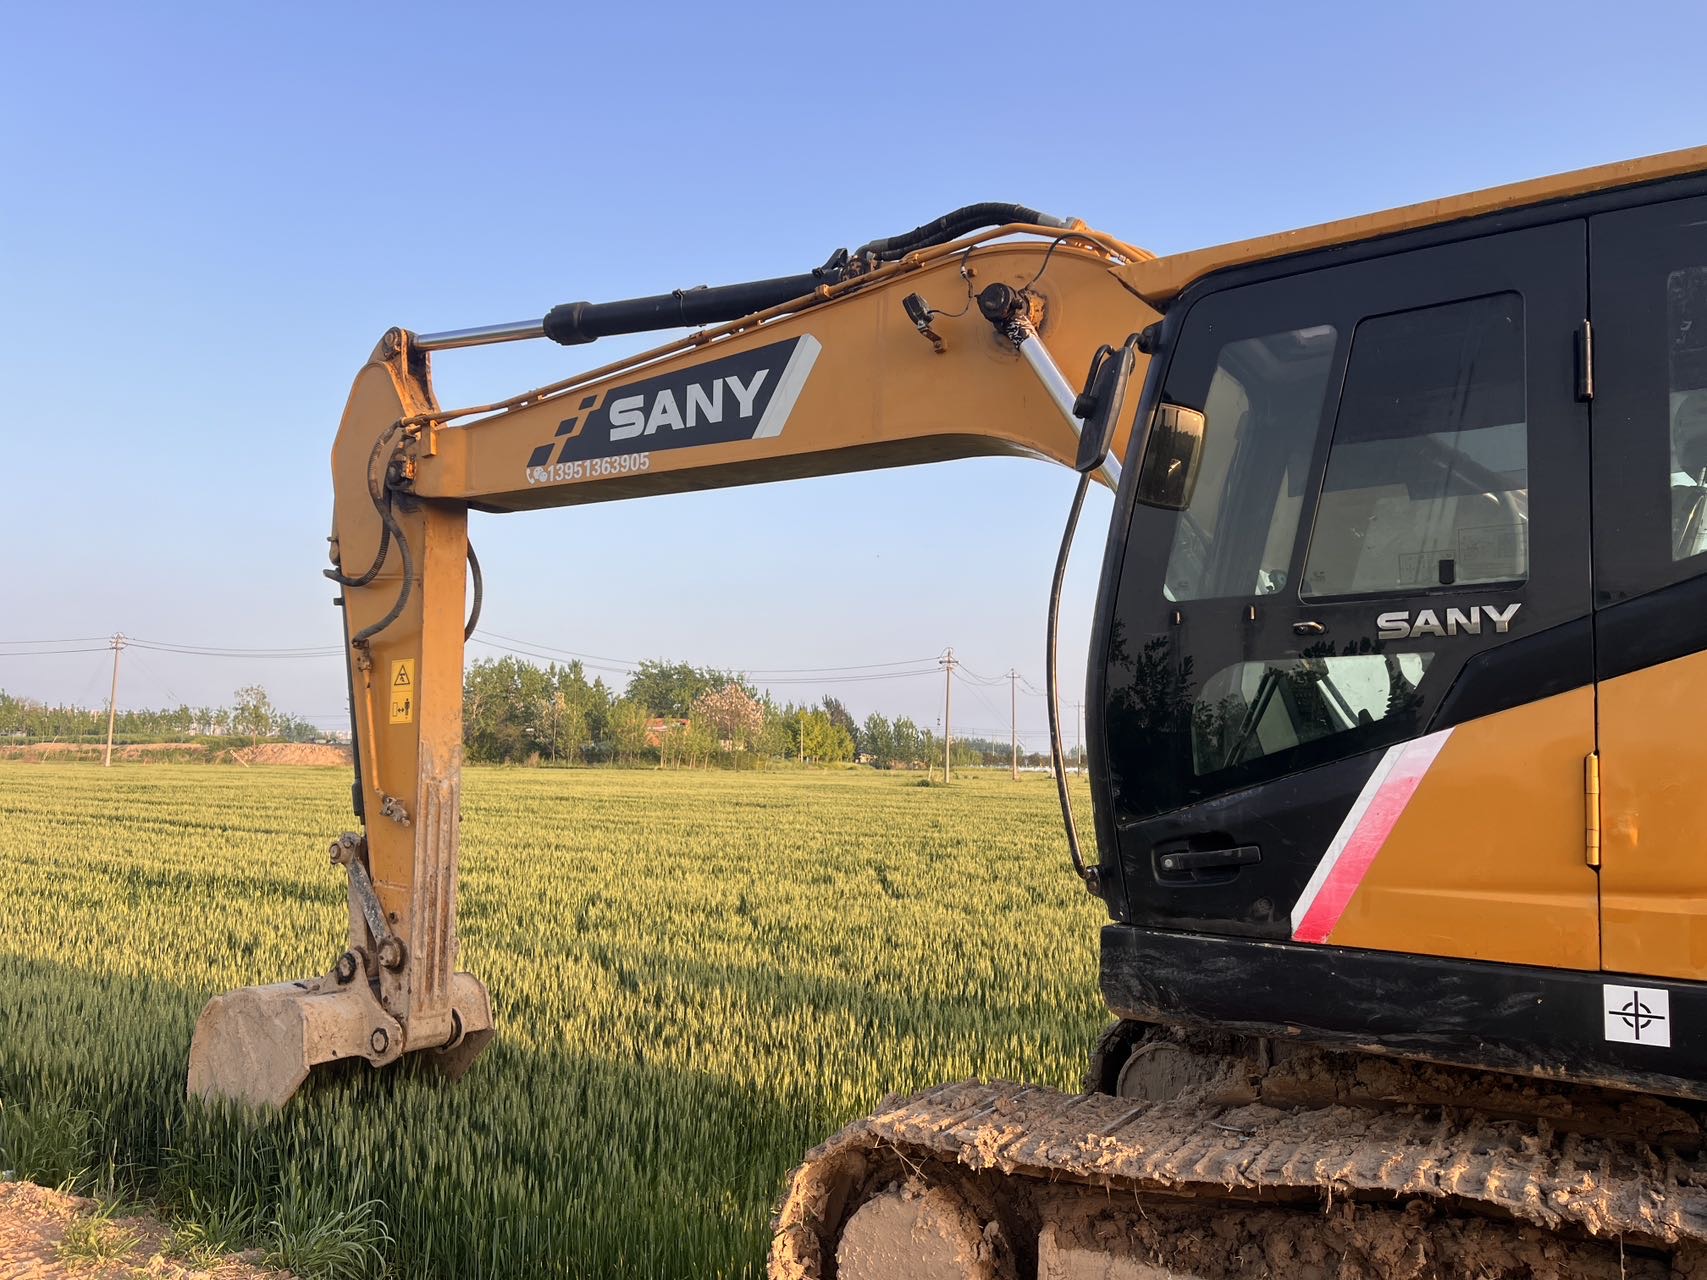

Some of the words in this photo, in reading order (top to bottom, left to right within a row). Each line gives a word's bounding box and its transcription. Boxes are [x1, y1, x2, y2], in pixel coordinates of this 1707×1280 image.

[610, 369, 769, 441] SANY
[547, 452, 650, 482] 13951363905
[1377, 603, 1521, 639] SANY
